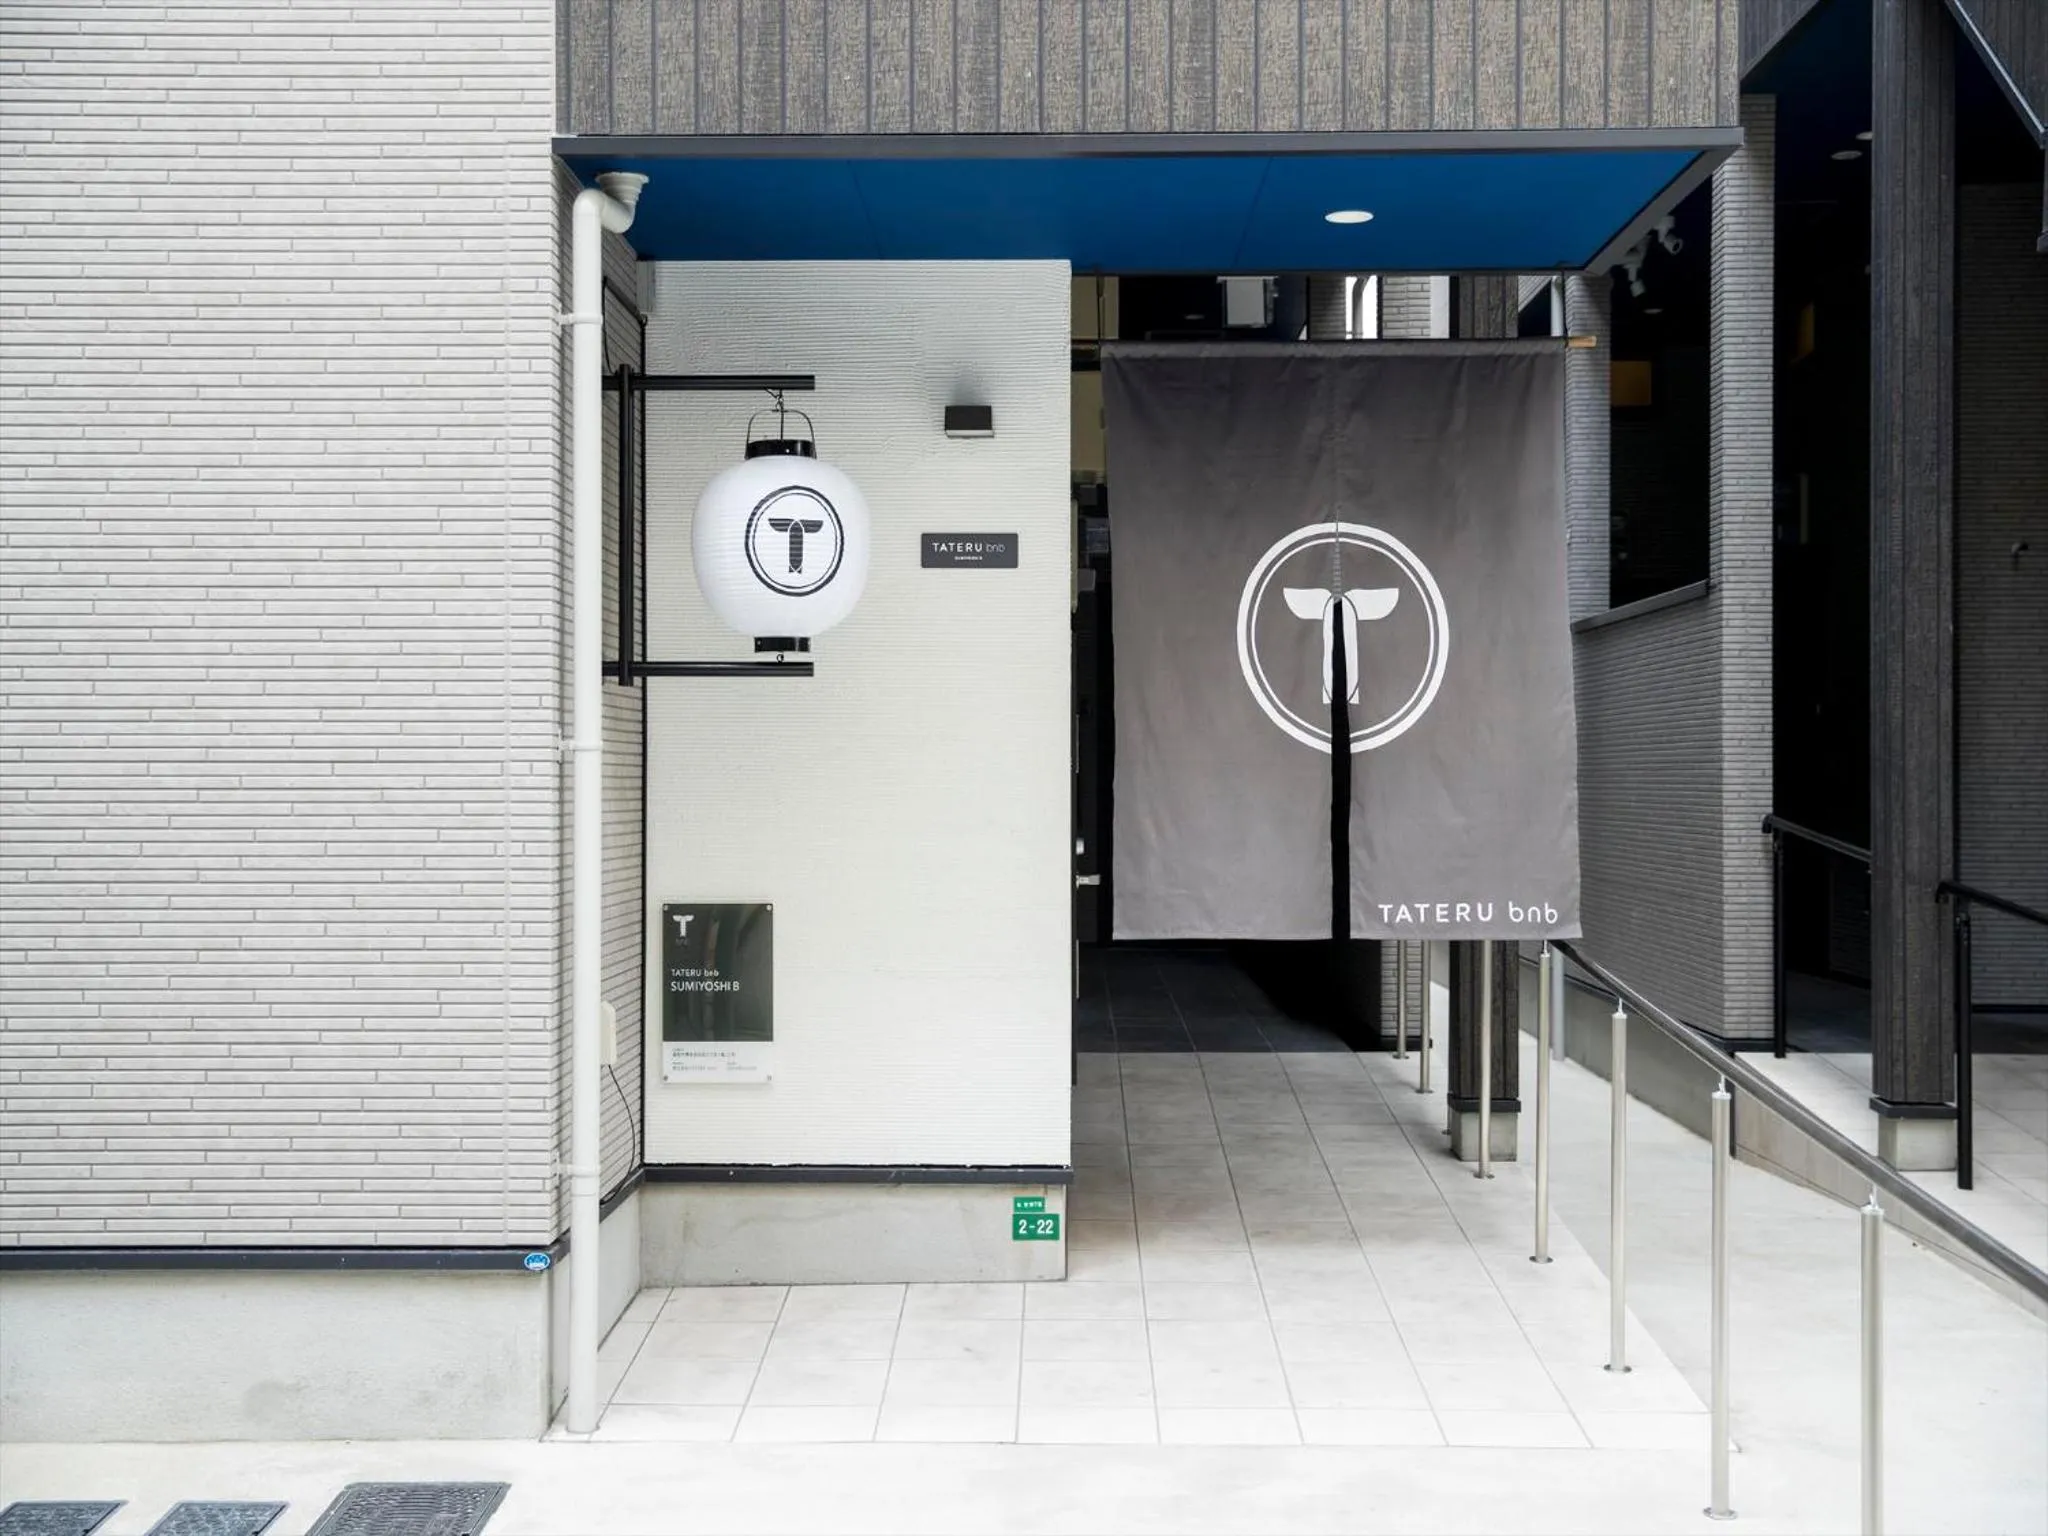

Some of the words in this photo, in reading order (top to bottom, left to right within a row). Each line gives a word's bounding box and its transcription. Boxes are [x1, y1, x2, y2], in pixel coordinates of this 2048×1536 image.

[768, 518, 824, 574] T
[932, 542, 983, 553] TATERU
[1378, 902, 1494, 923] TATERU
[1508, 901, 1559, 924] bnb
[672, 914, 695, 938] T
[671, 969, 702, 977] TATERU
[1018, 1219, 1054, 1234] 2-22
